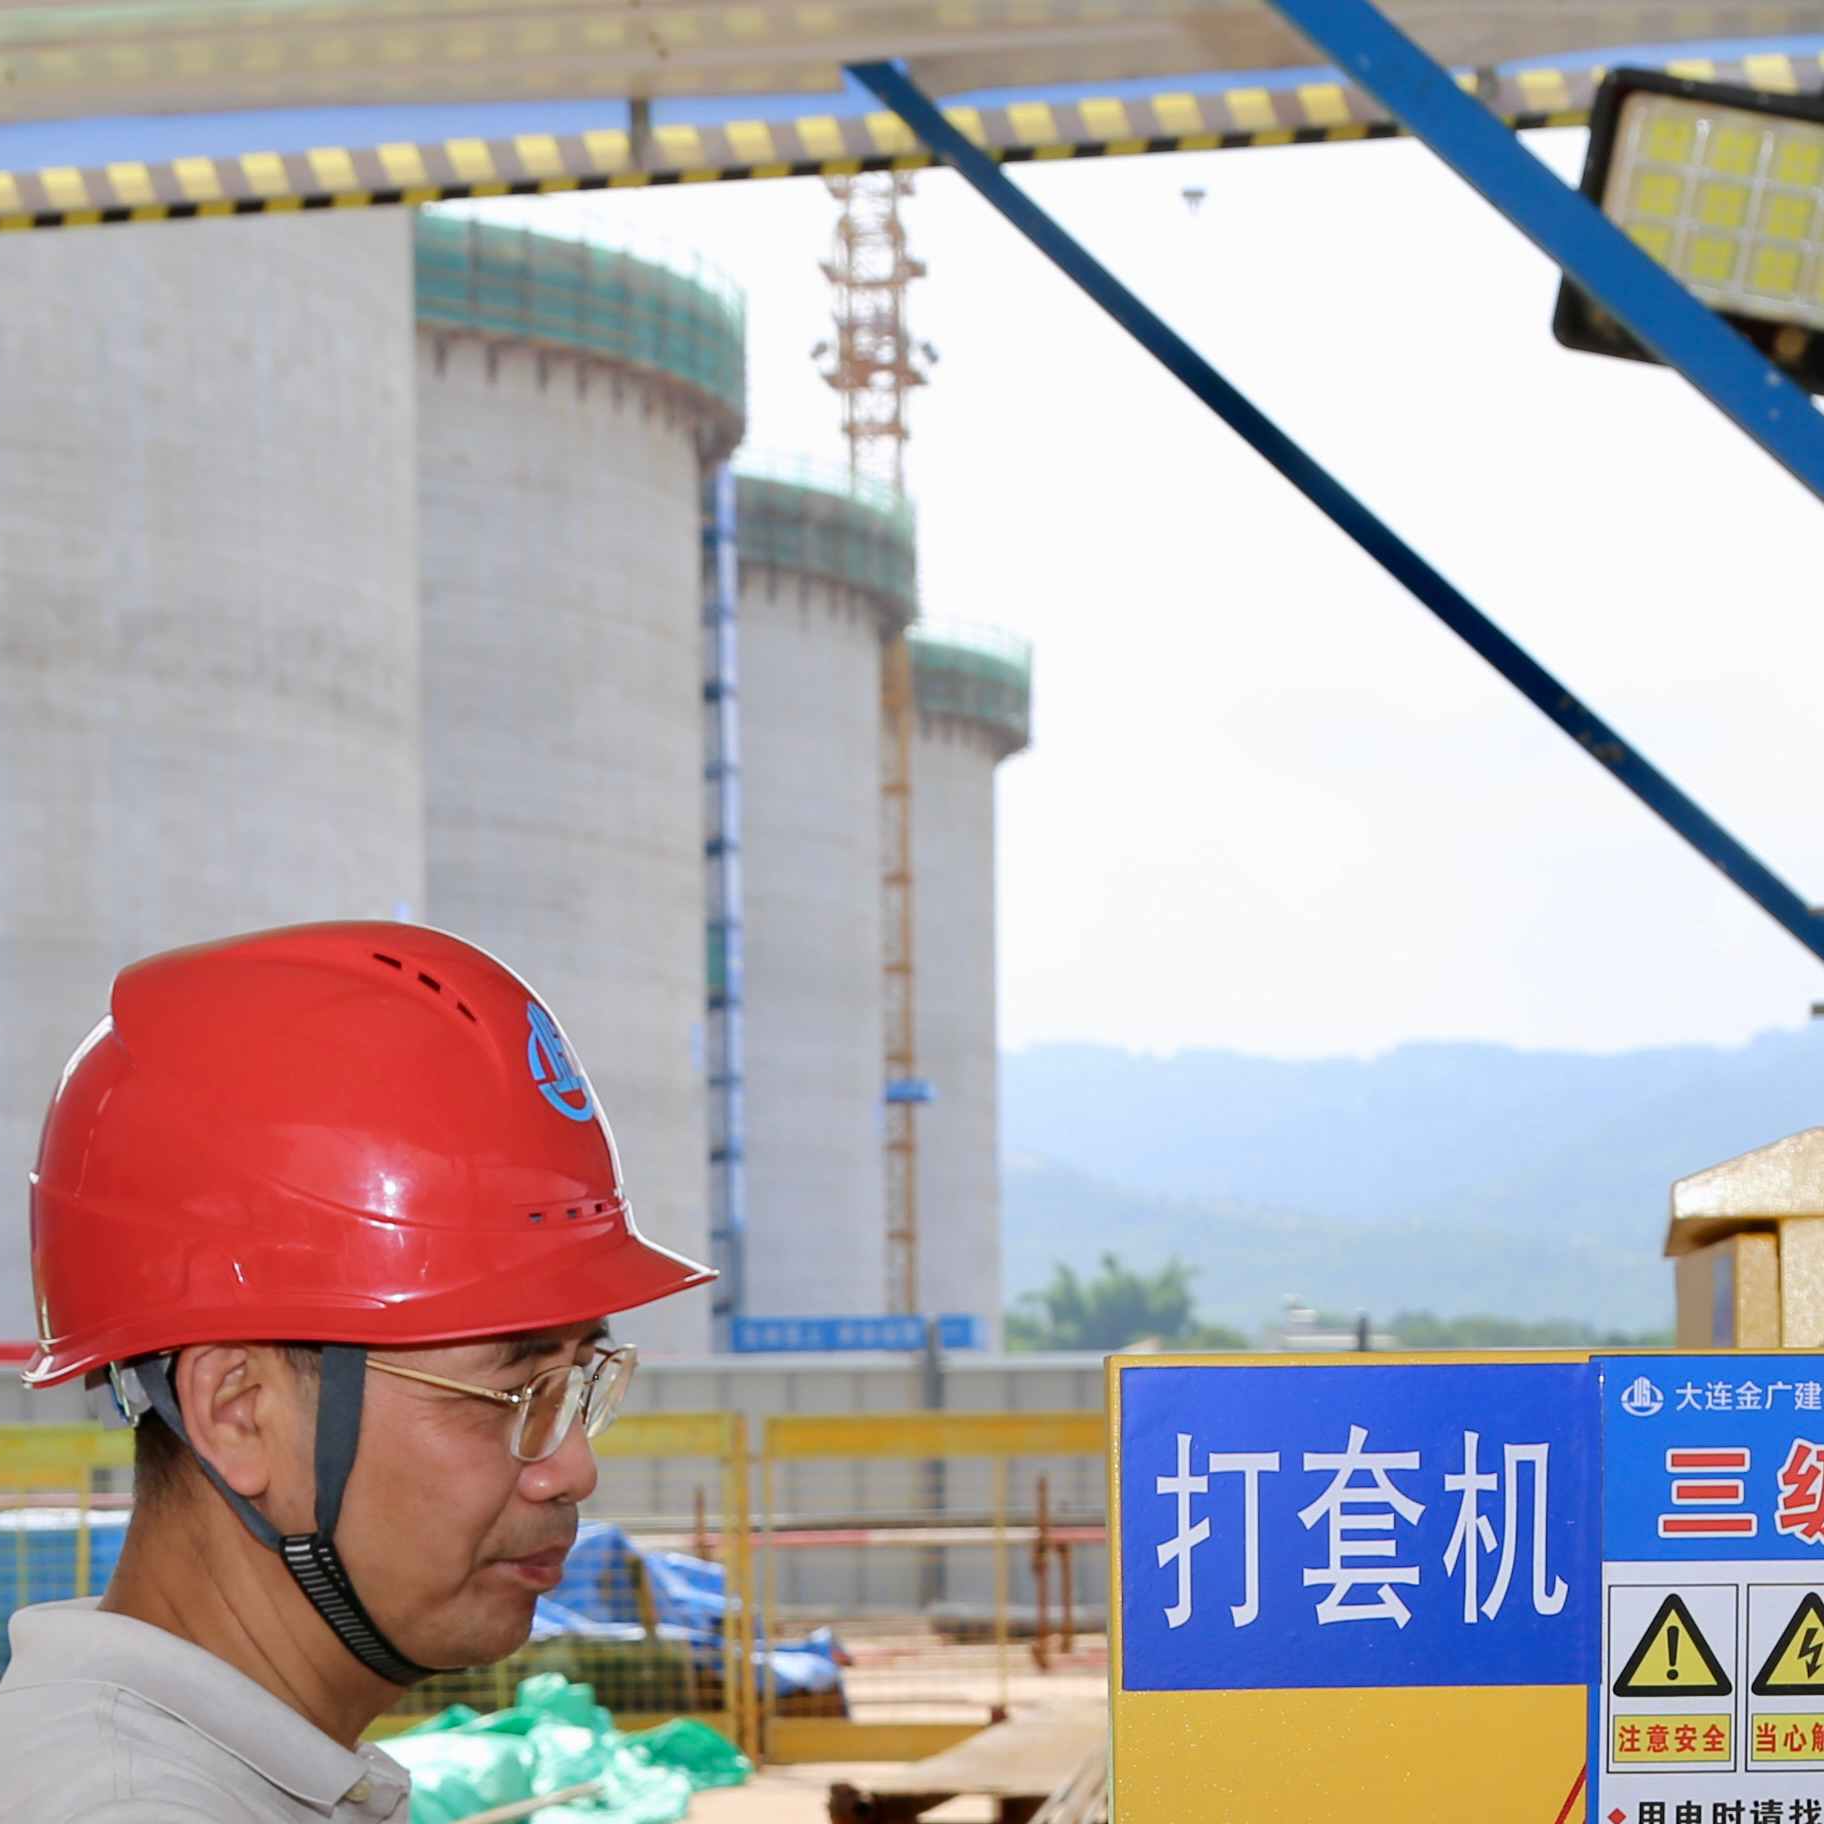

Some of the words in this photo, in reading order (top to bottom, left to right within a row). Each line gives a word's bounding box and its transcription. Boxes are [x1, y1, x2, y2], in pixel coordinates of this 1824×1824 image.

[1156, 1424, 1569, 1631] 打套机
[1618, 1724, 1726, 1753] 注意安全
